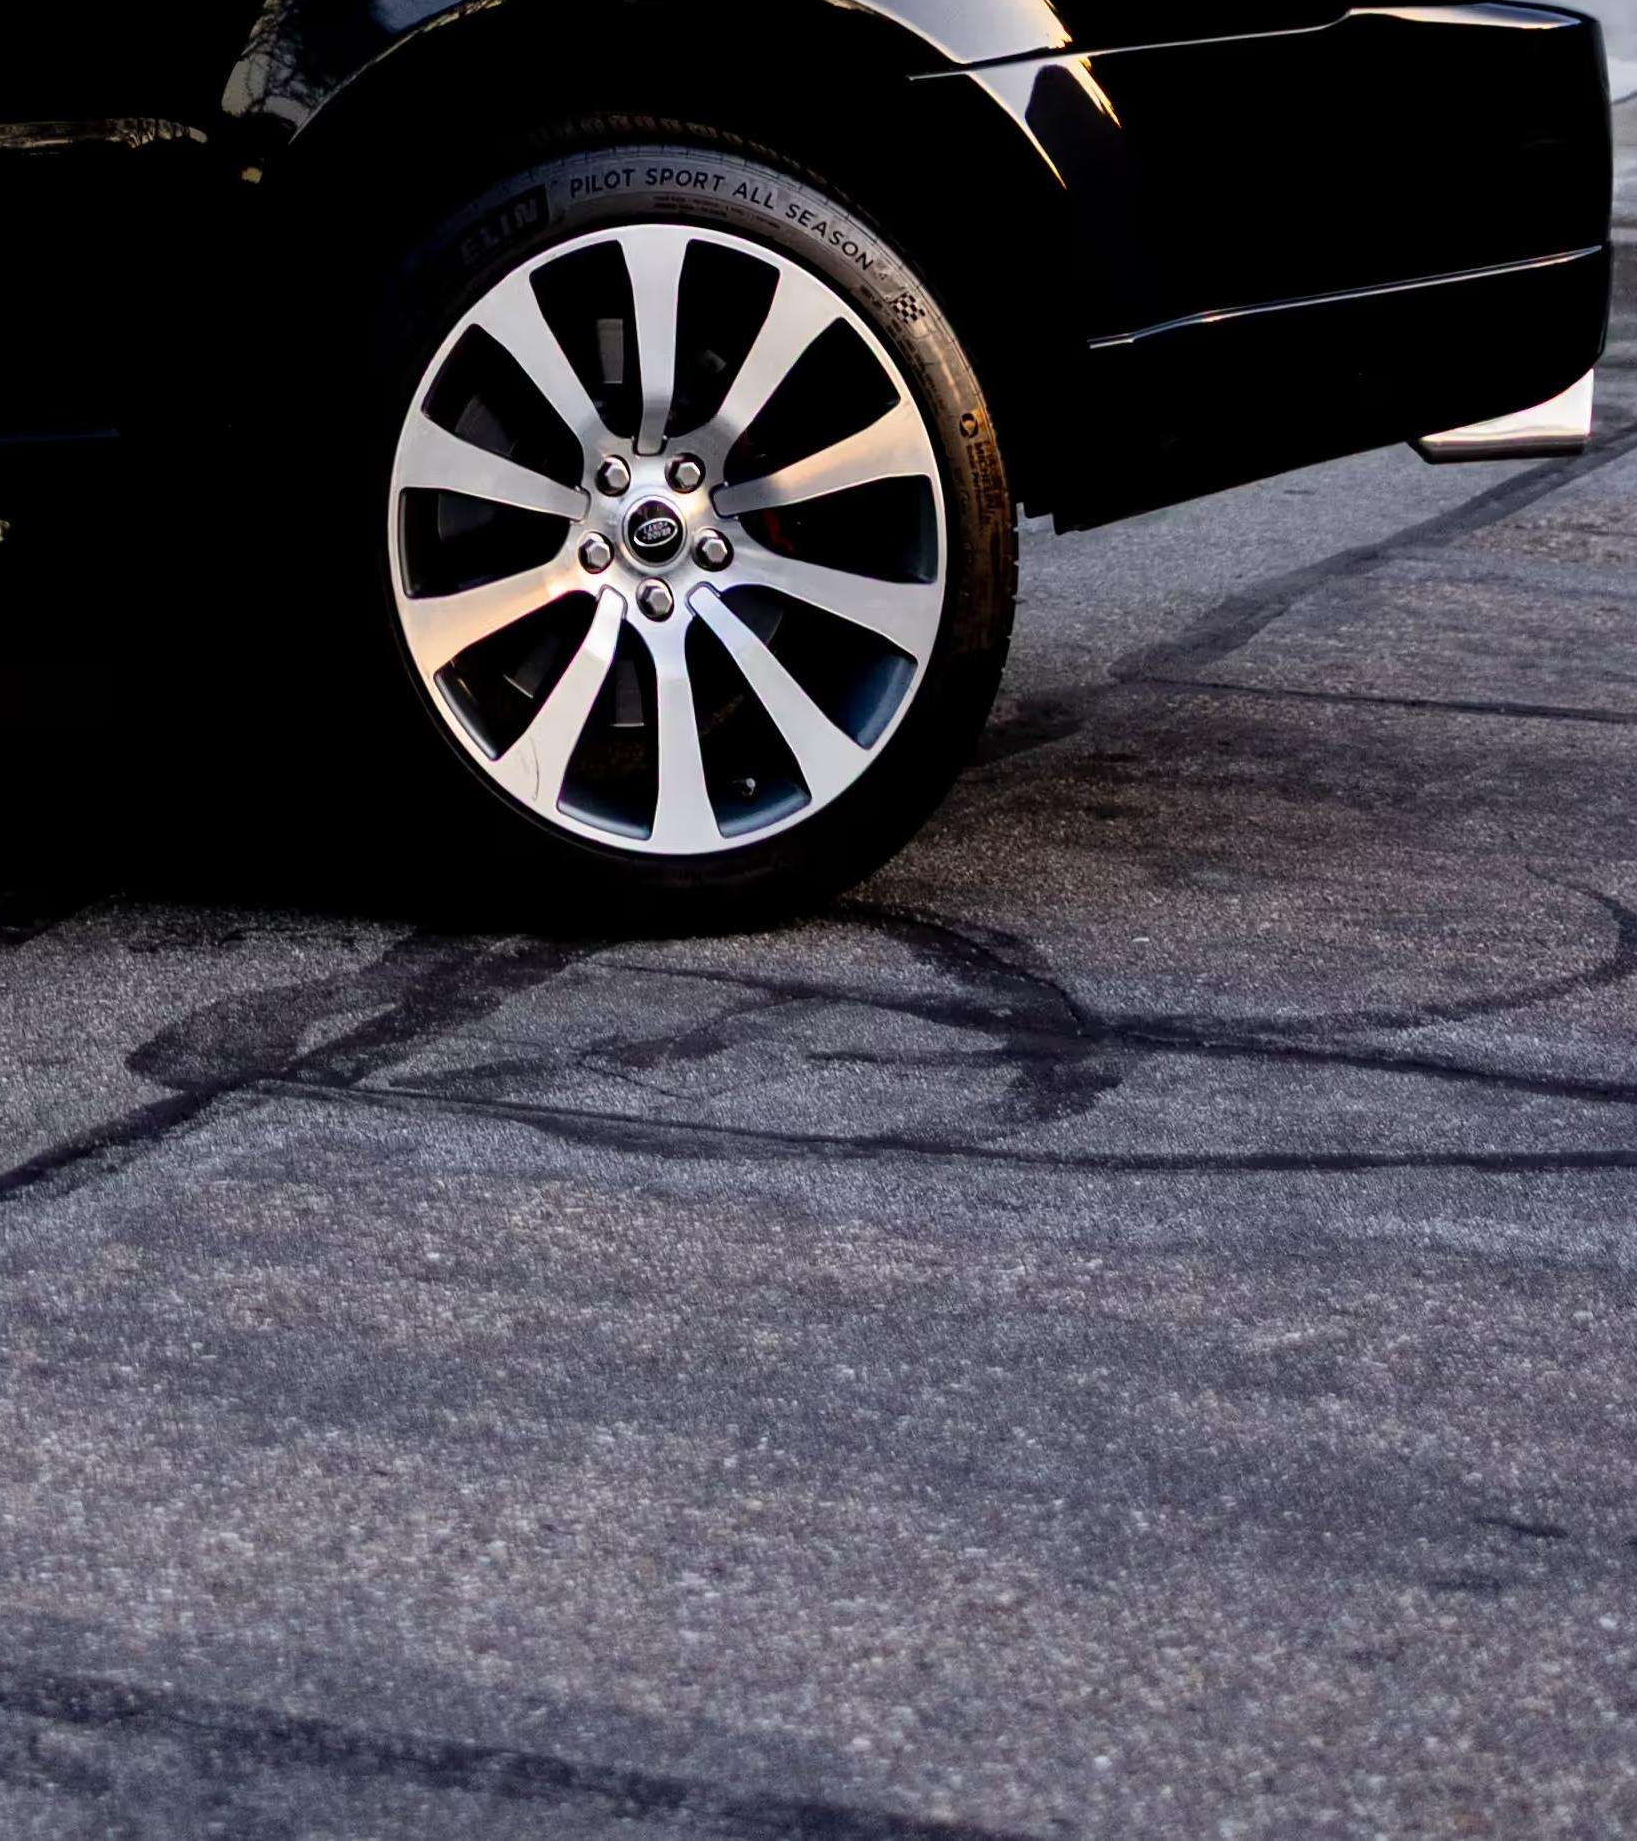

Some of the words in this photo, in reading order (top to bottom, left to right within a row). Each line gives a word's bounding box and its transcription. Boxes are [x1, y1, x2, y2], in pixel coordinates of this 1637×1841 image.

[570, 168, 636, 199] PILOT
[646, 168, 725, 191] SPORT
[732, 181, 774, 209] ALL
[785, 203, 874, 271] SEASON
